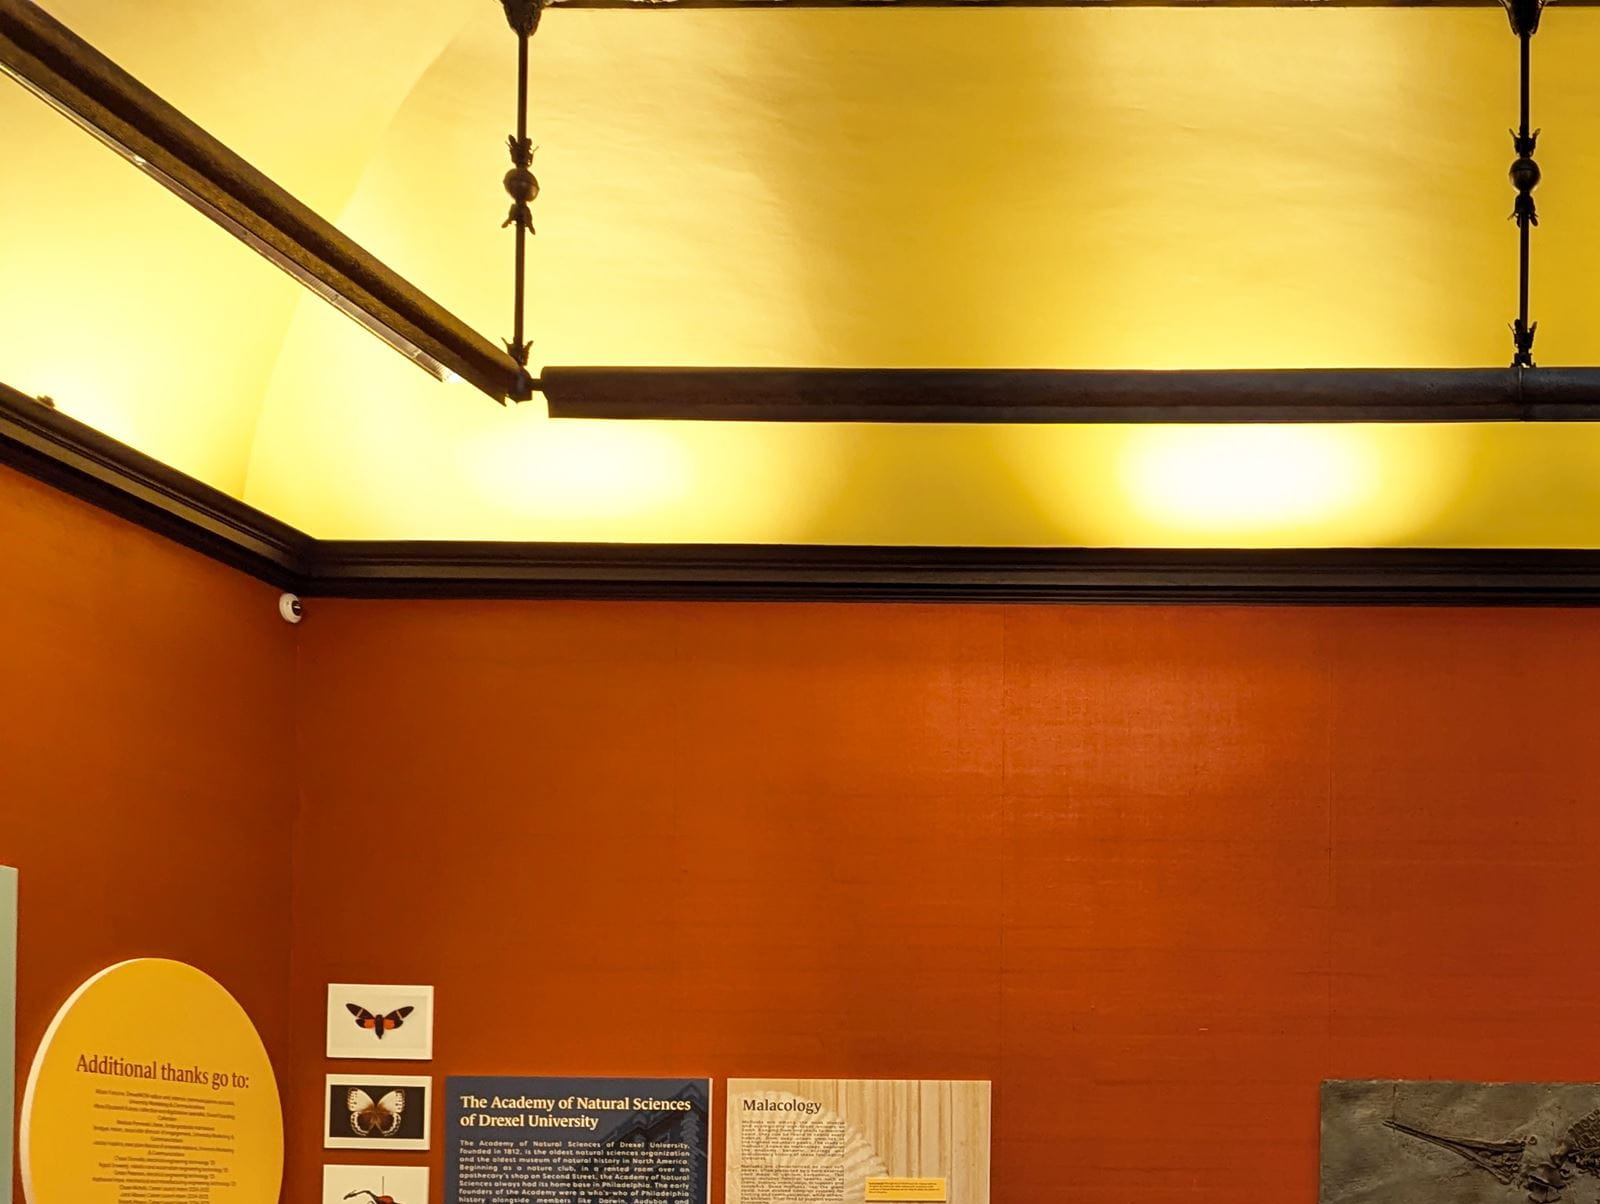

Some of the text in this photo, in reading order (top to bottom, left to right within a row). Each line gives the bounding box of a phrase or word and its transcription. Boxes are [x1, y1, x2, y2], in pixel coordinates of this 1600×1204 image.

[76, 1054, 250, 1090] Additional thanks go to:
[460, 1096, 692, 1114] The Academy of Natural Sciences
[744, 1098, 822, 1114] Malacology
[460, 1114, 598, 1130] of Drexel University
